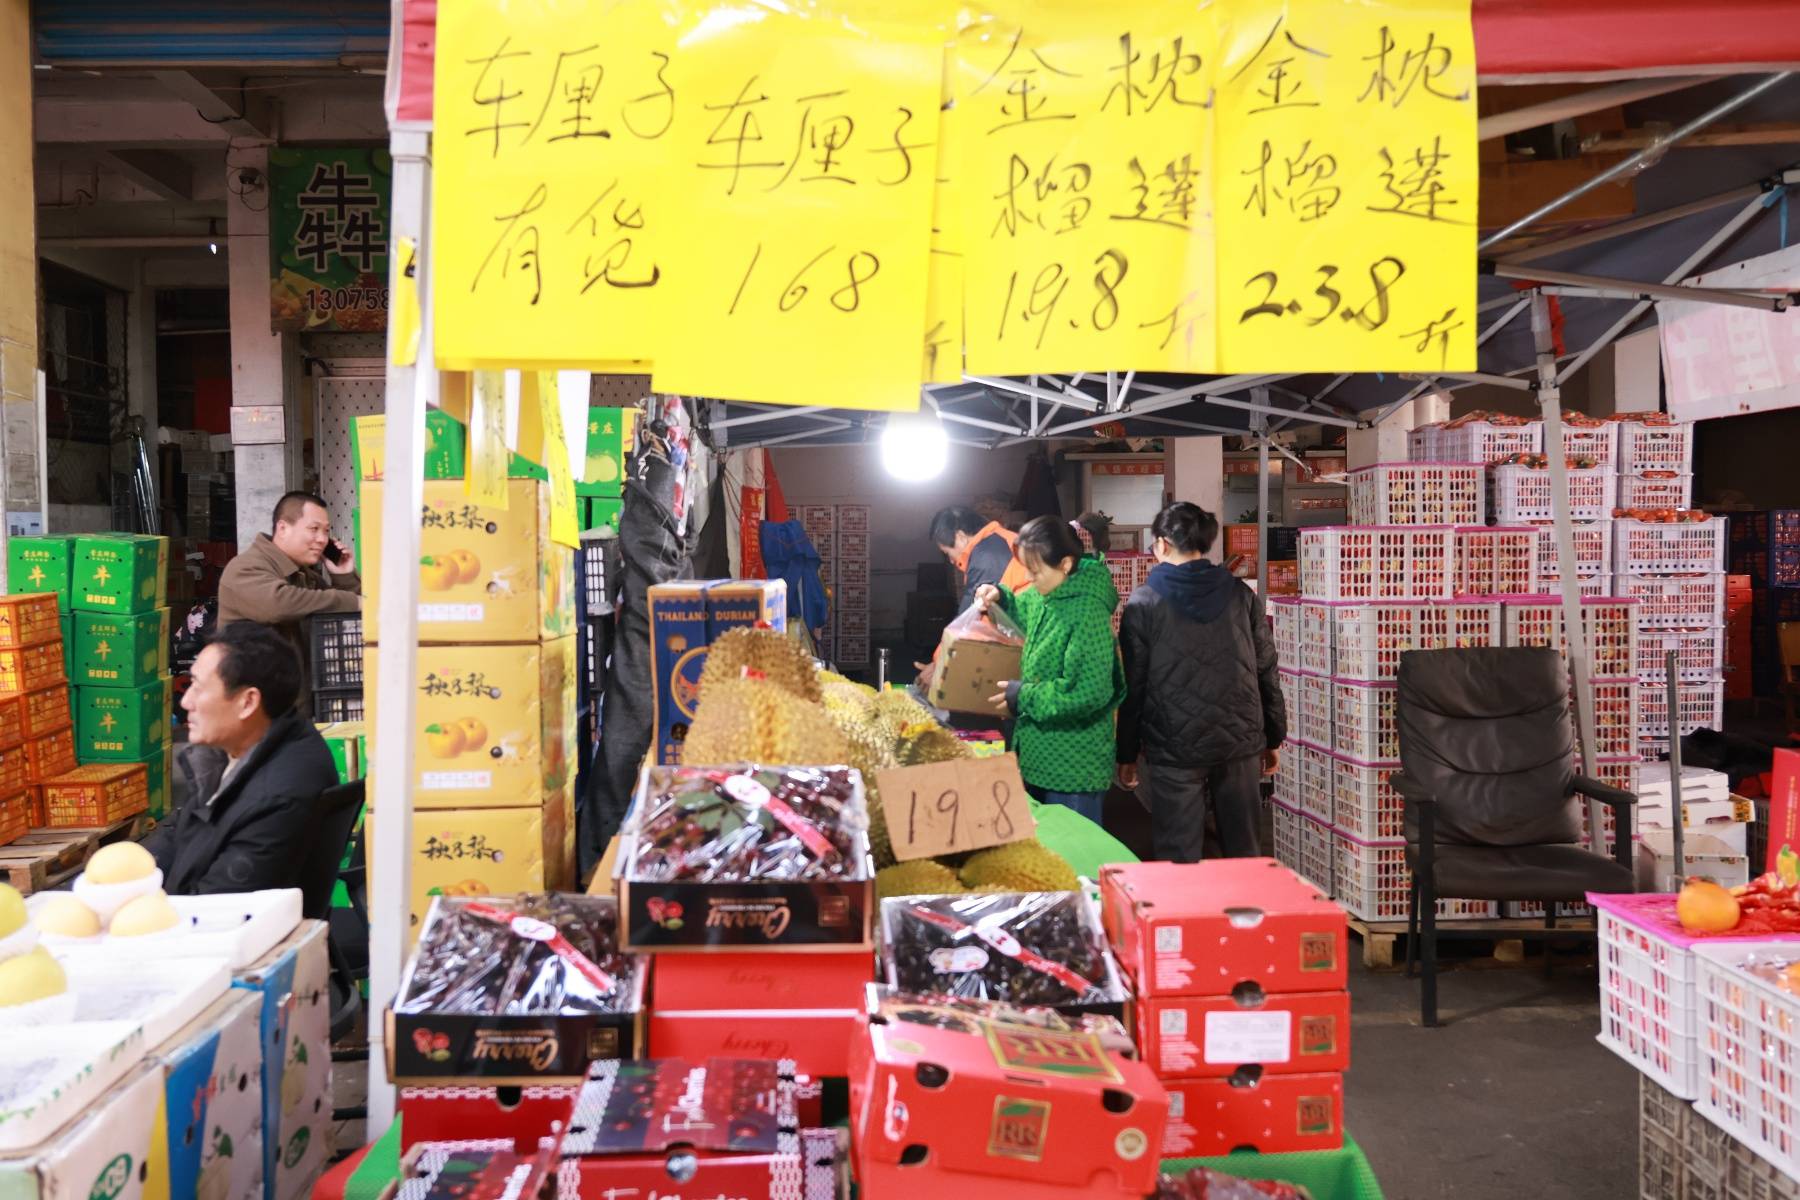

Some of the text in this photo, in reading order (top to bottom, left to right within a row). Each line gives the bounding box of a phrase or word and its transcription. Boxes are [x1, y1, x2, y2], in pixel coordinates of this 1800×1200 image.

[465, 37, 675, 159] 车厘子
[971, 27, 1215, 135] 金枕
[1230, 15, 1471, 115] 金枕
[697, 75, 935, 196] 车厘子
[296, 163, 387, 272] 犇
[471, 180, 660, 305] 有货
[728, 244, 879, 316] 168
[715, 610, 756, 621] DURIAN
